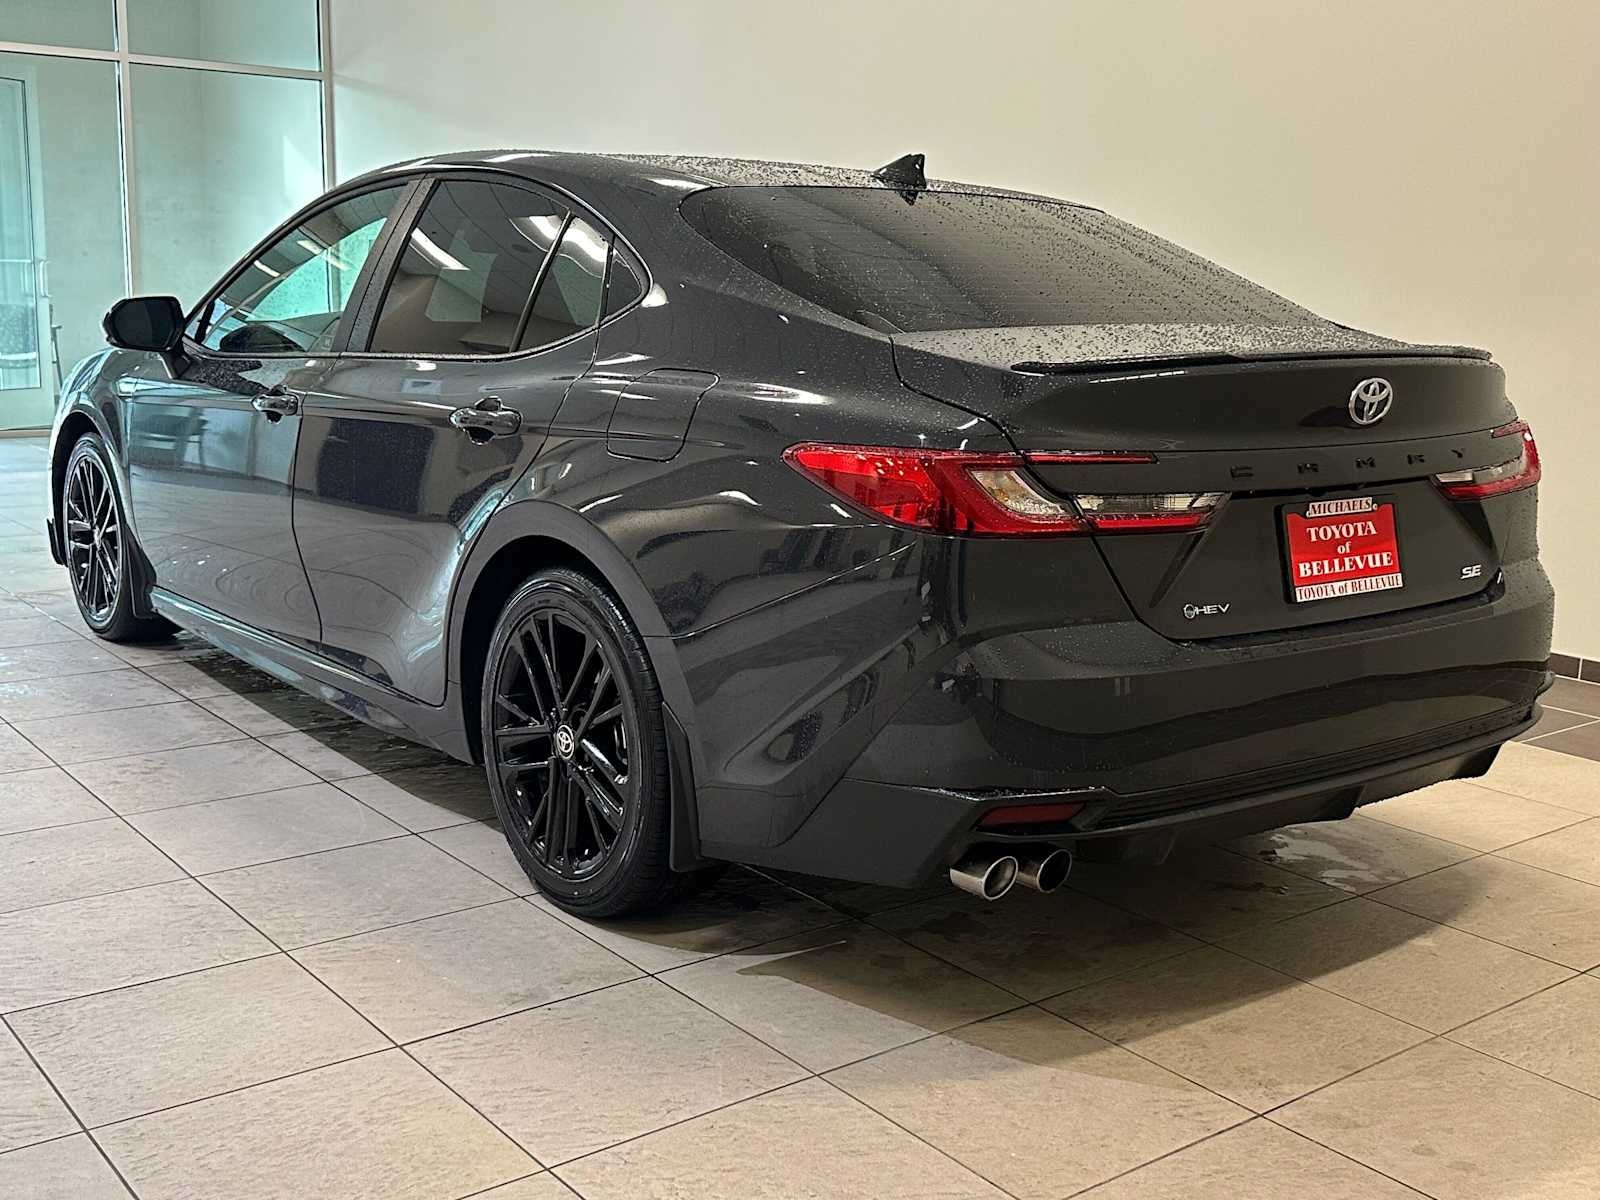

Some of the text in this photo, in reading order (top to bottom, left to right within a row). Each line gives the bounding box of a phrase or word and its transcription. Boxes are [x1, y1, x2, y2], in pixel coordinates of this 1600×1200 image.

[1230, 449, 1465, 478] CAMRY
[1310, 499, 1371, 515] MICHAELS
[1307, 521, 1377, 542] TOYOTA
[1337, 541, 1351, 554] of
[1298, 552, 1393, 578] BELLEVUE
[1460, 564, 1482, 580] SE
[1297, 574, 1401, 600] TOYOTA of BELLEVUE
[1194, 603, 1230, 615] HEV
